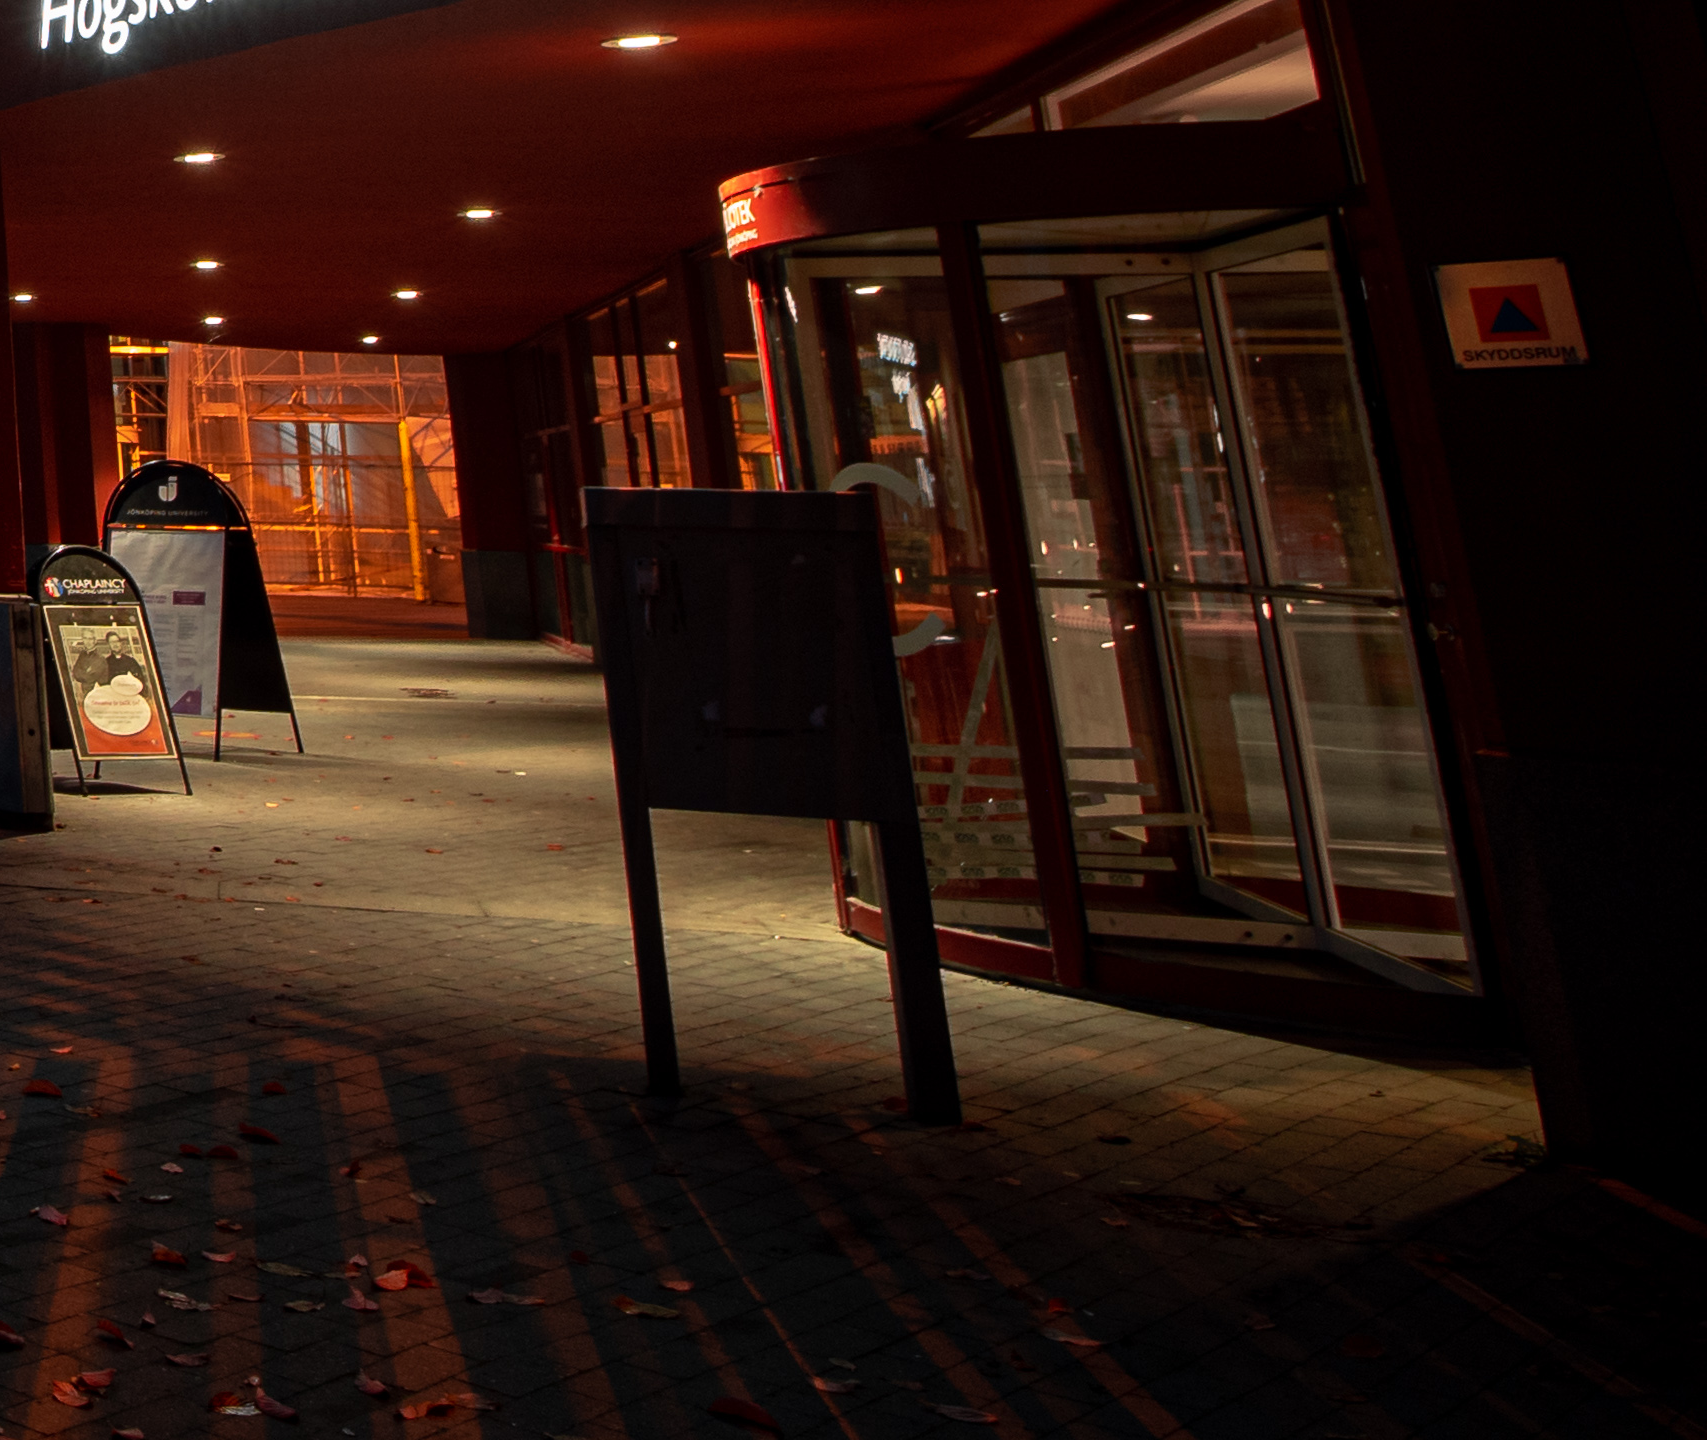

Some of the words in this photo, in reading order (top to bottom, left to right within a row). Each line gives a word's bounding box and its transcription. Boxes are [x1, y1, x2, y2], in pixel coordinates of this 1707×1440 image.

[1462, 346, 1576, 362] SKYDDSRUM
[167, 508, 209, 517] UNIVERSITY
[62, 578, 127, 589] CHAPLAINCY
